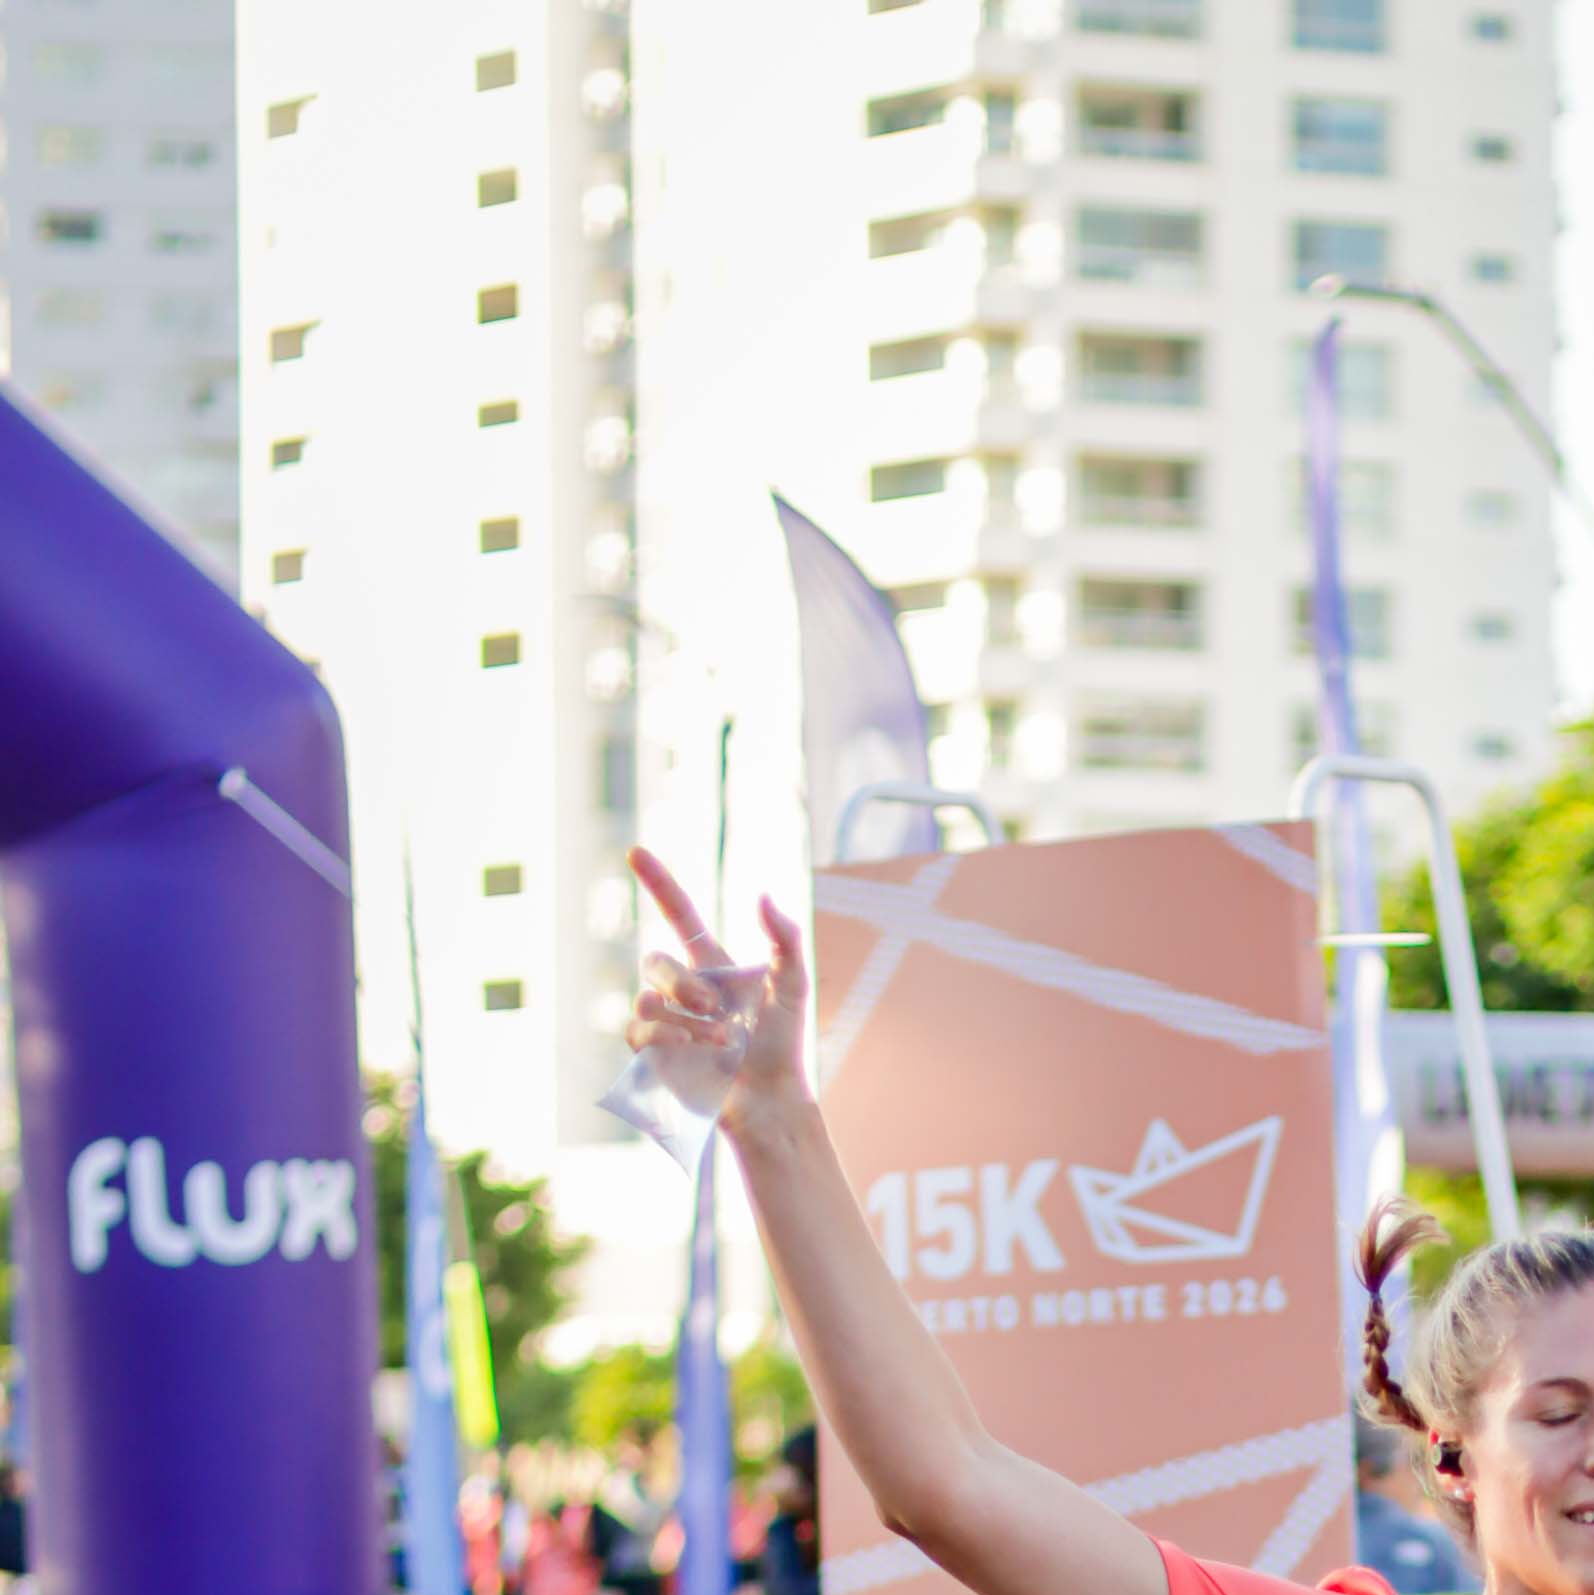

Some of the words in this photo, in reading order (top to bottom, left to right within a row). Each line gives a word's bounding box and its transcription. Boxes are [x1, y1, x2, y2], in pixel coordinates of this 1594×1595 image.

[866, 1159, 1065, 1280] 15K
[916, 1298, 1020, 1335] ERTO
[1032, 1284, 1167, 1327] NORTE
[1181, 1276, 1288, 1318] 2026
